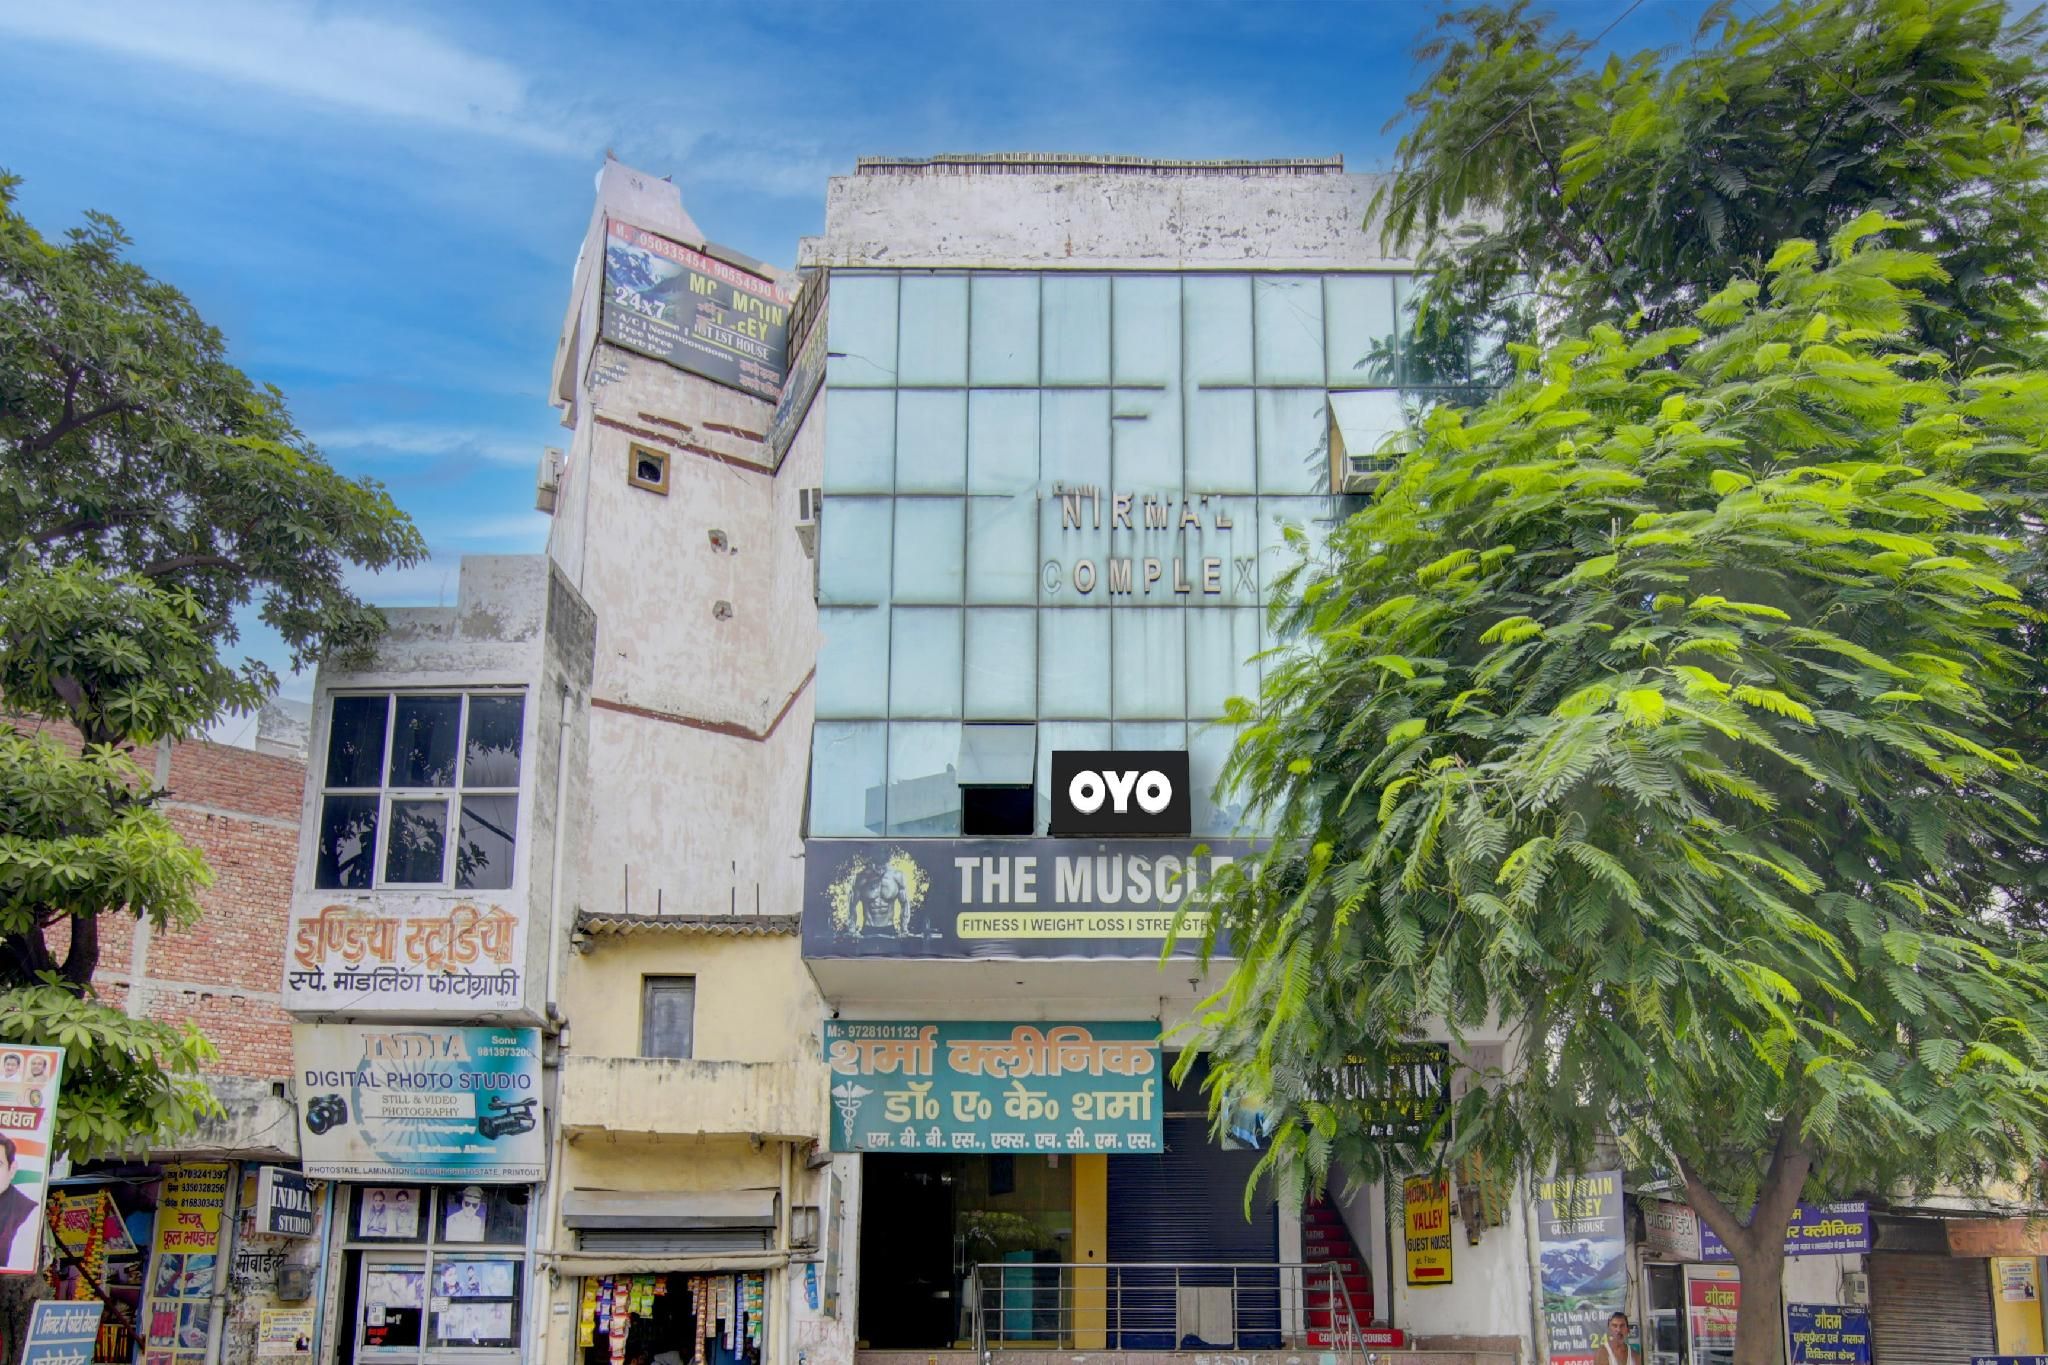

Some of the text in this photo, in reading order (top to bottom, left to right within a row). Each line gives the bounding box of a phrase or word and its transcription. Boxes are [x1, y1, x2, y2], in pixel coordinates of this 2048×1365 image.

[736, 337, 770, 361] HOUSE
[1062, 482, 1233, 529] NIRMAL
[1042, 557, 1257, 595] COMPLEX
[1069, 770, 1173, 814] OYO
[954, 856, 1037, 904] THE
[962, 918, 1019, 932] FITNESS
[1030, 918, 1085, 932] WEIGHT
[1088, 918, 1125, 932] LOSS
[1136, 918, 1209, 932] STREGTH
[427, 968, 521, 1000] फोटोग्राफी
[491, 1035, 517, 1045] Sonu
[848, 1025, 918, 1039] 9728101123
[361, 1033, 472, 1062] INDIA
[829, 1025, 1161, 1079] शर्मा क्लीनिक
[305, 1070, 532, 1089] DIGITAL PHOTO STUDIO
[381, 1094, 458, 1106] STILL & VIDEO
[1071, 1078, 1155, 1122] शर्मा
[0, 1108, 37, 1129] बंधन
[381, 1107, 460, 1118] PHOTOGRAPHY
[502, 1168, 541, 1176] PRINTOUT
[271, 1186, 312, 1213] INDIA
[278, 1214, 311, 1234] STUDIO
[1413, 1208, 1443, 1231] VALLEY
[1803, 1219, 1864, 1238] क्लीनिक
[163, 1230, 217, 1250] फूल भण्डार
[1407, 1234, 1449, 1251] GUEST HOUSE
[1362, 1333, 1392, 1343] COURSE
[1552, 1326, 1567, 1337] Free
[1553, 1340, 1571, 1351] Party
